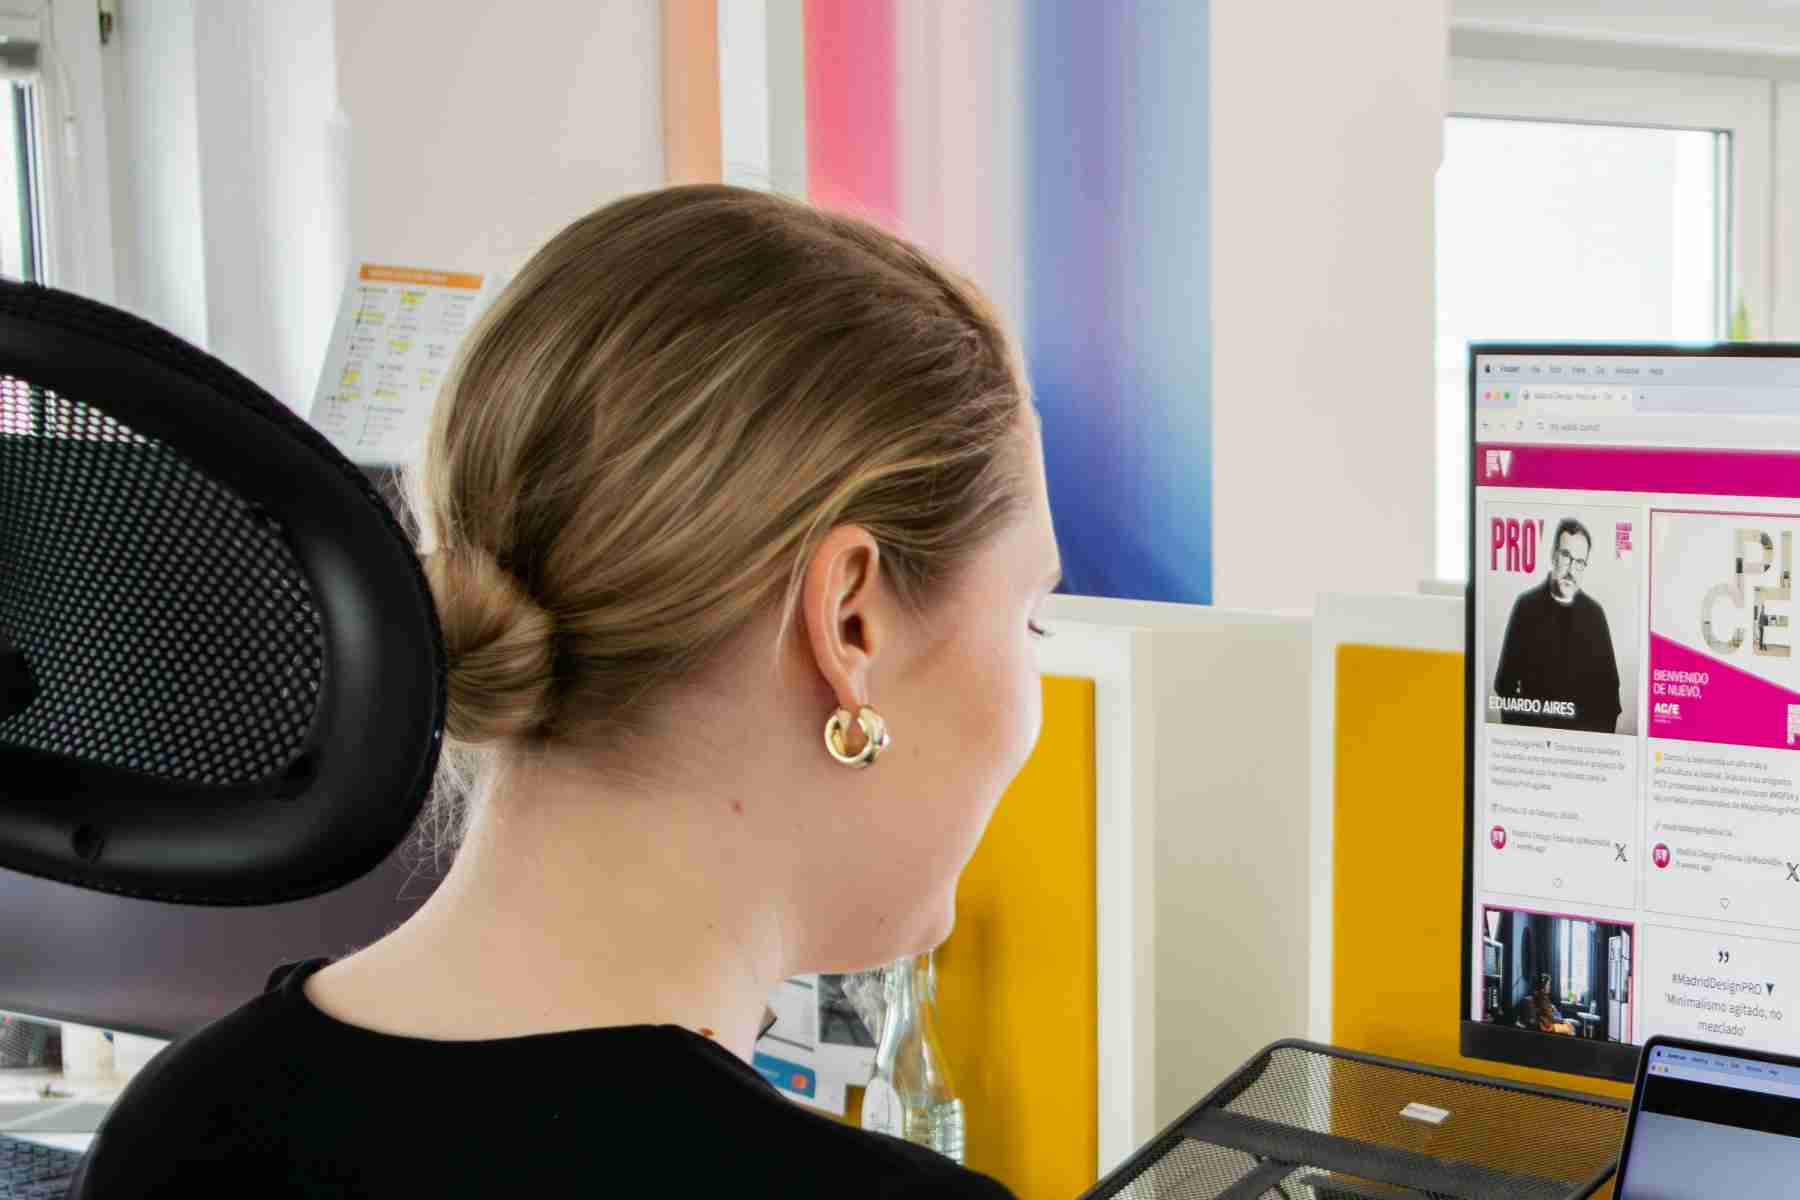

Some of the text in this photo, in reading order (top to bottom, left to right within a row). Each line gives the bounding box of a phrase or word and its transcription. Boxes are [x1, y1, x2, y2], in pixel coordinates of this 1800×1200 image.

[1488, 696, 1576, 717] EDUARDO AIRES
[1769, 1009, 1783, 1020] no
